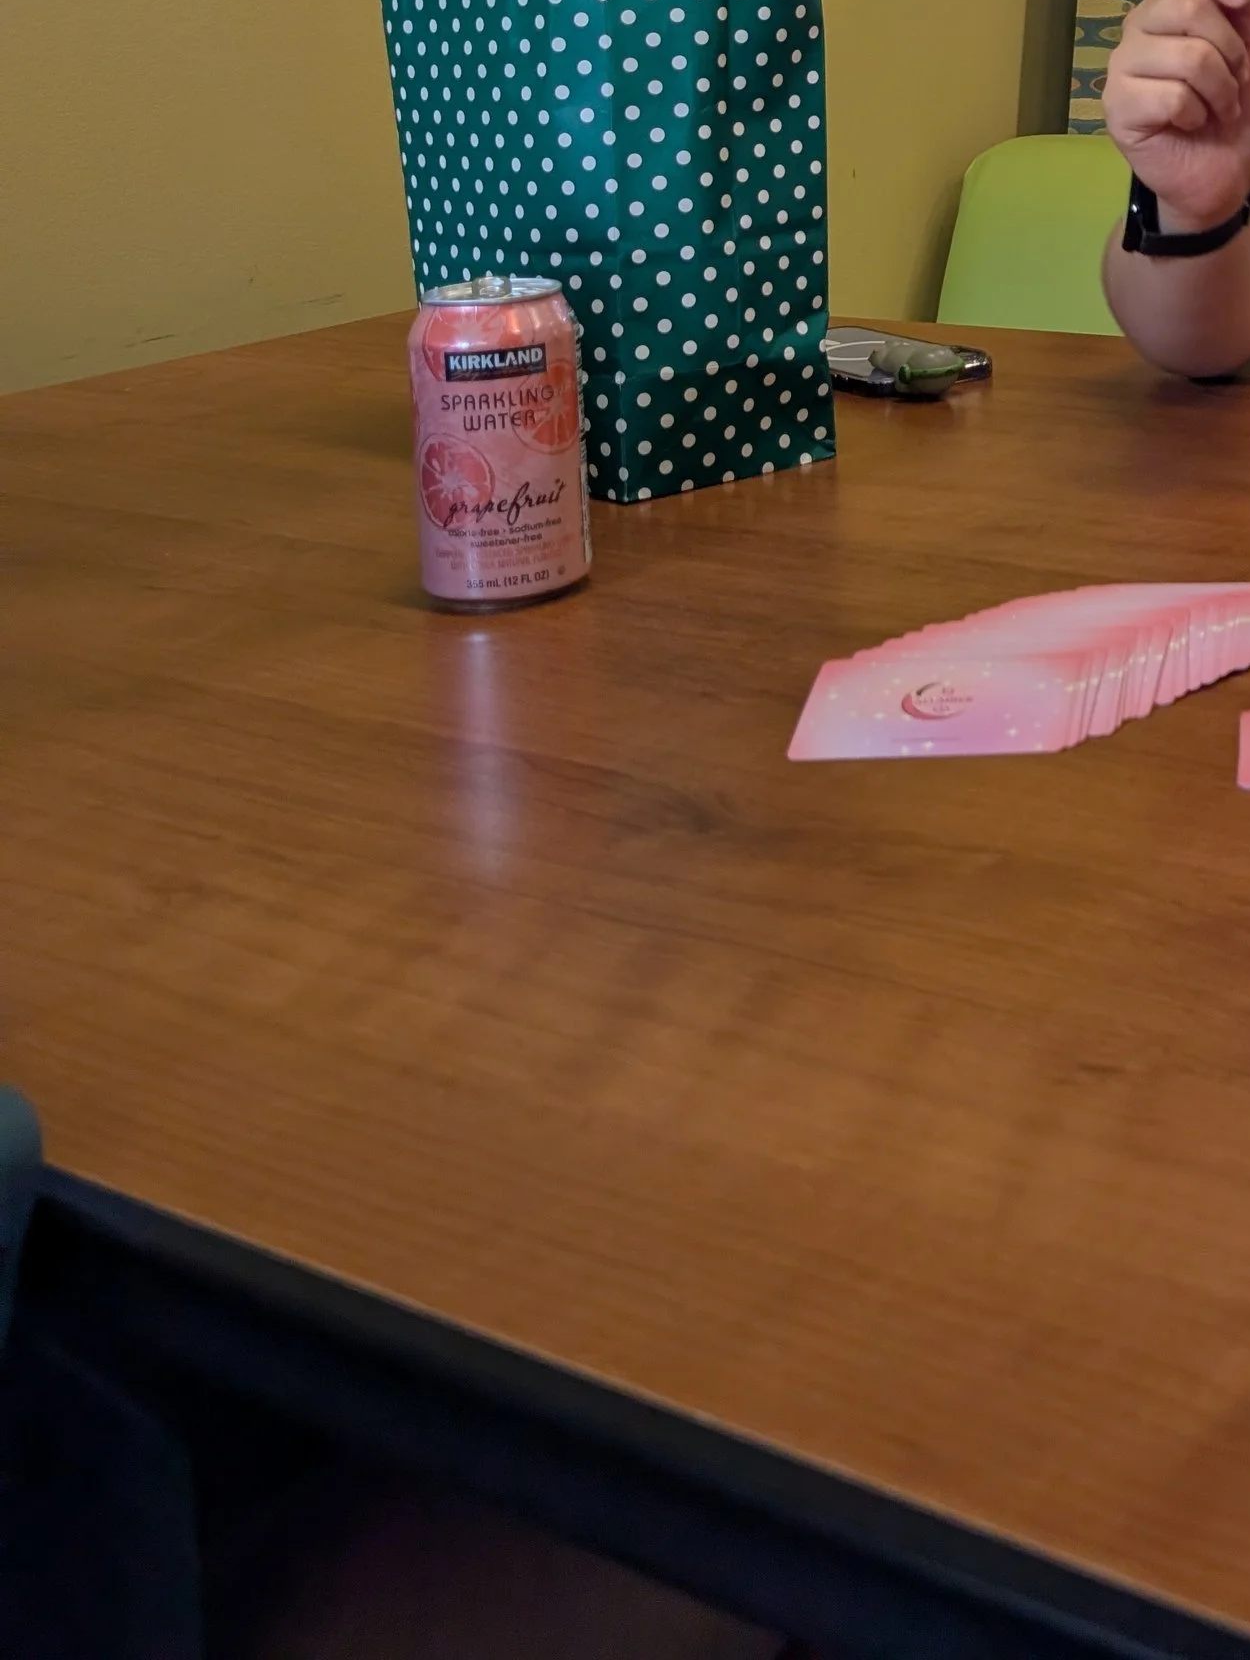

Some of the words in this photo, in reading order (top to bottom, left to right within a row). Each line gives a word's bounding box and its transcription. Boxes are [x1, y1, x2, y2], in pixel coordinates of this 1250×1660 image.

[449, 347, 543, 371] KIRKLAND
[440, 384, 554, 411] SPARKLING
[463, 409, 536, 431] WATER
[443, 478, 566, 528] grapefruit
[508, 516, 562, 534] sodium-free
[470, 532, 543, 549] sweetener-free
[466, 579, 484, 589] 355
